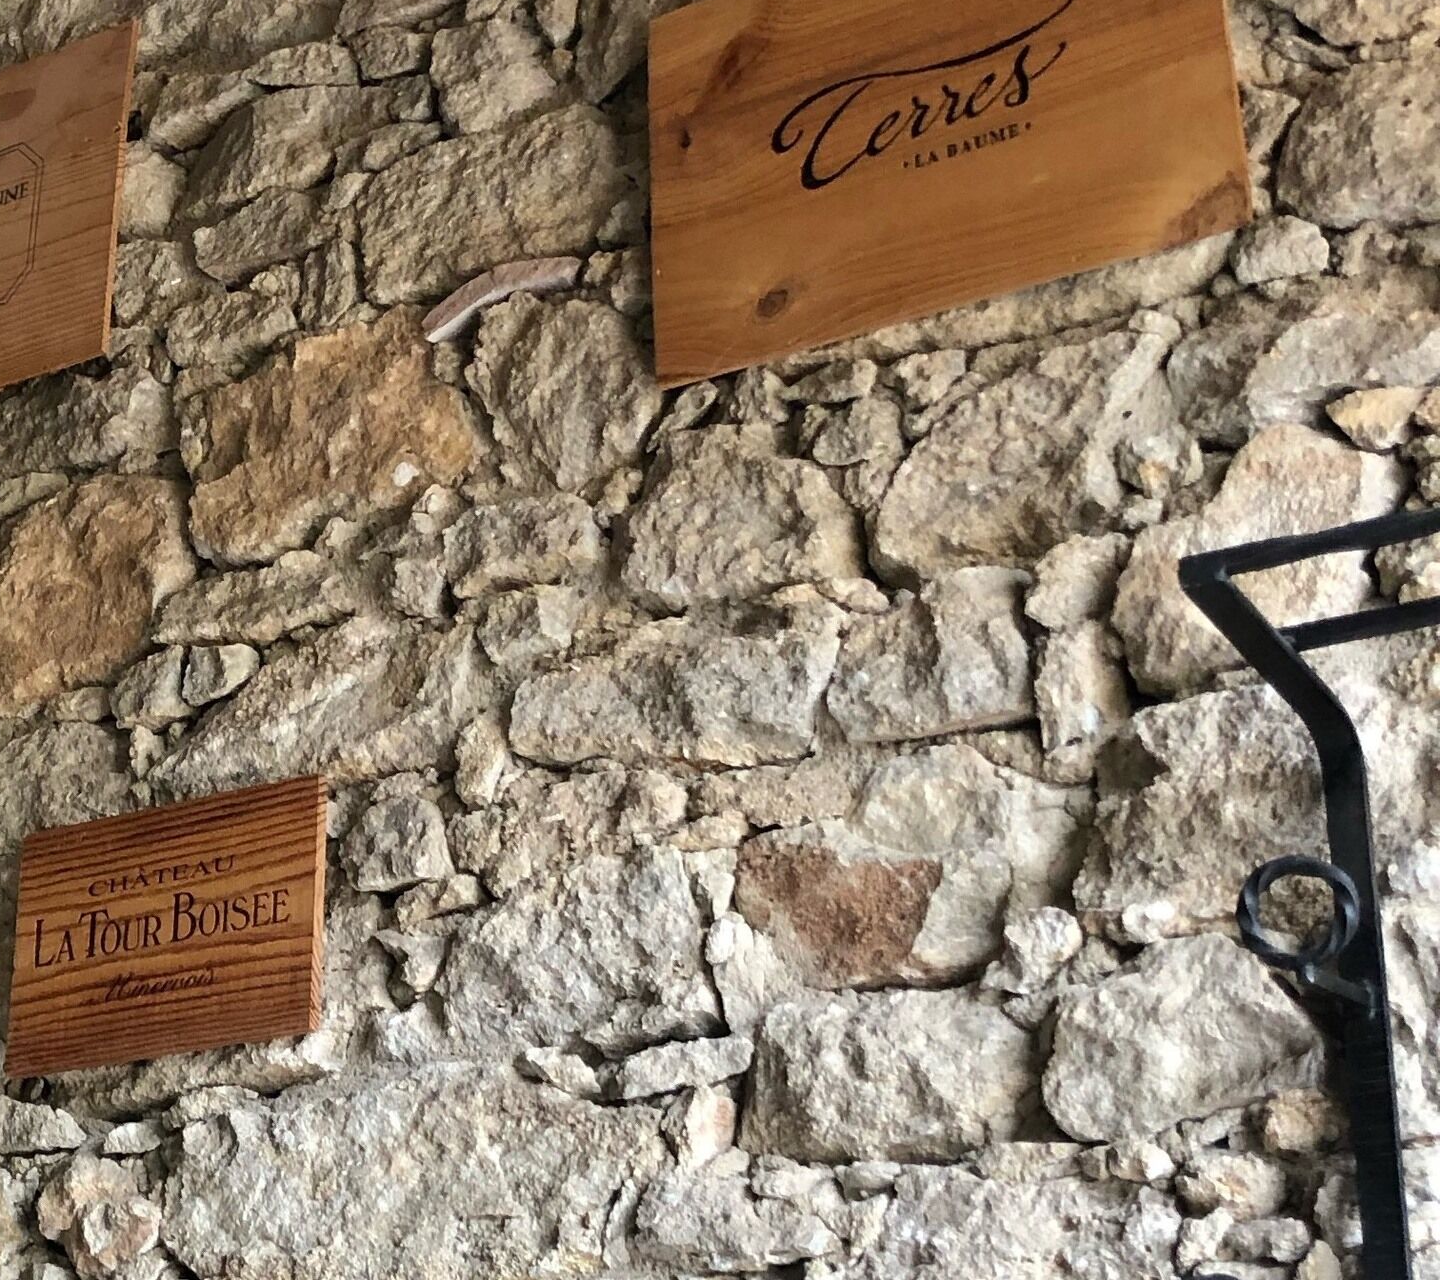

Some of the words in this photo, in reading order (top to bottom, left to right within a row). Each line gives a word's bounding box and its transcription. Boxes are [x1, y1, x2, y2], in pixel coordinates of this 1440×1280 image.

[914, 152, 940, 169] LA
[946, 123, 1020, 159] BAUME
[88, 854, 236, 897] CHÂTEAU
[34, 919, 75, 969] LA
[77, 908, 162, 959] TOUR
